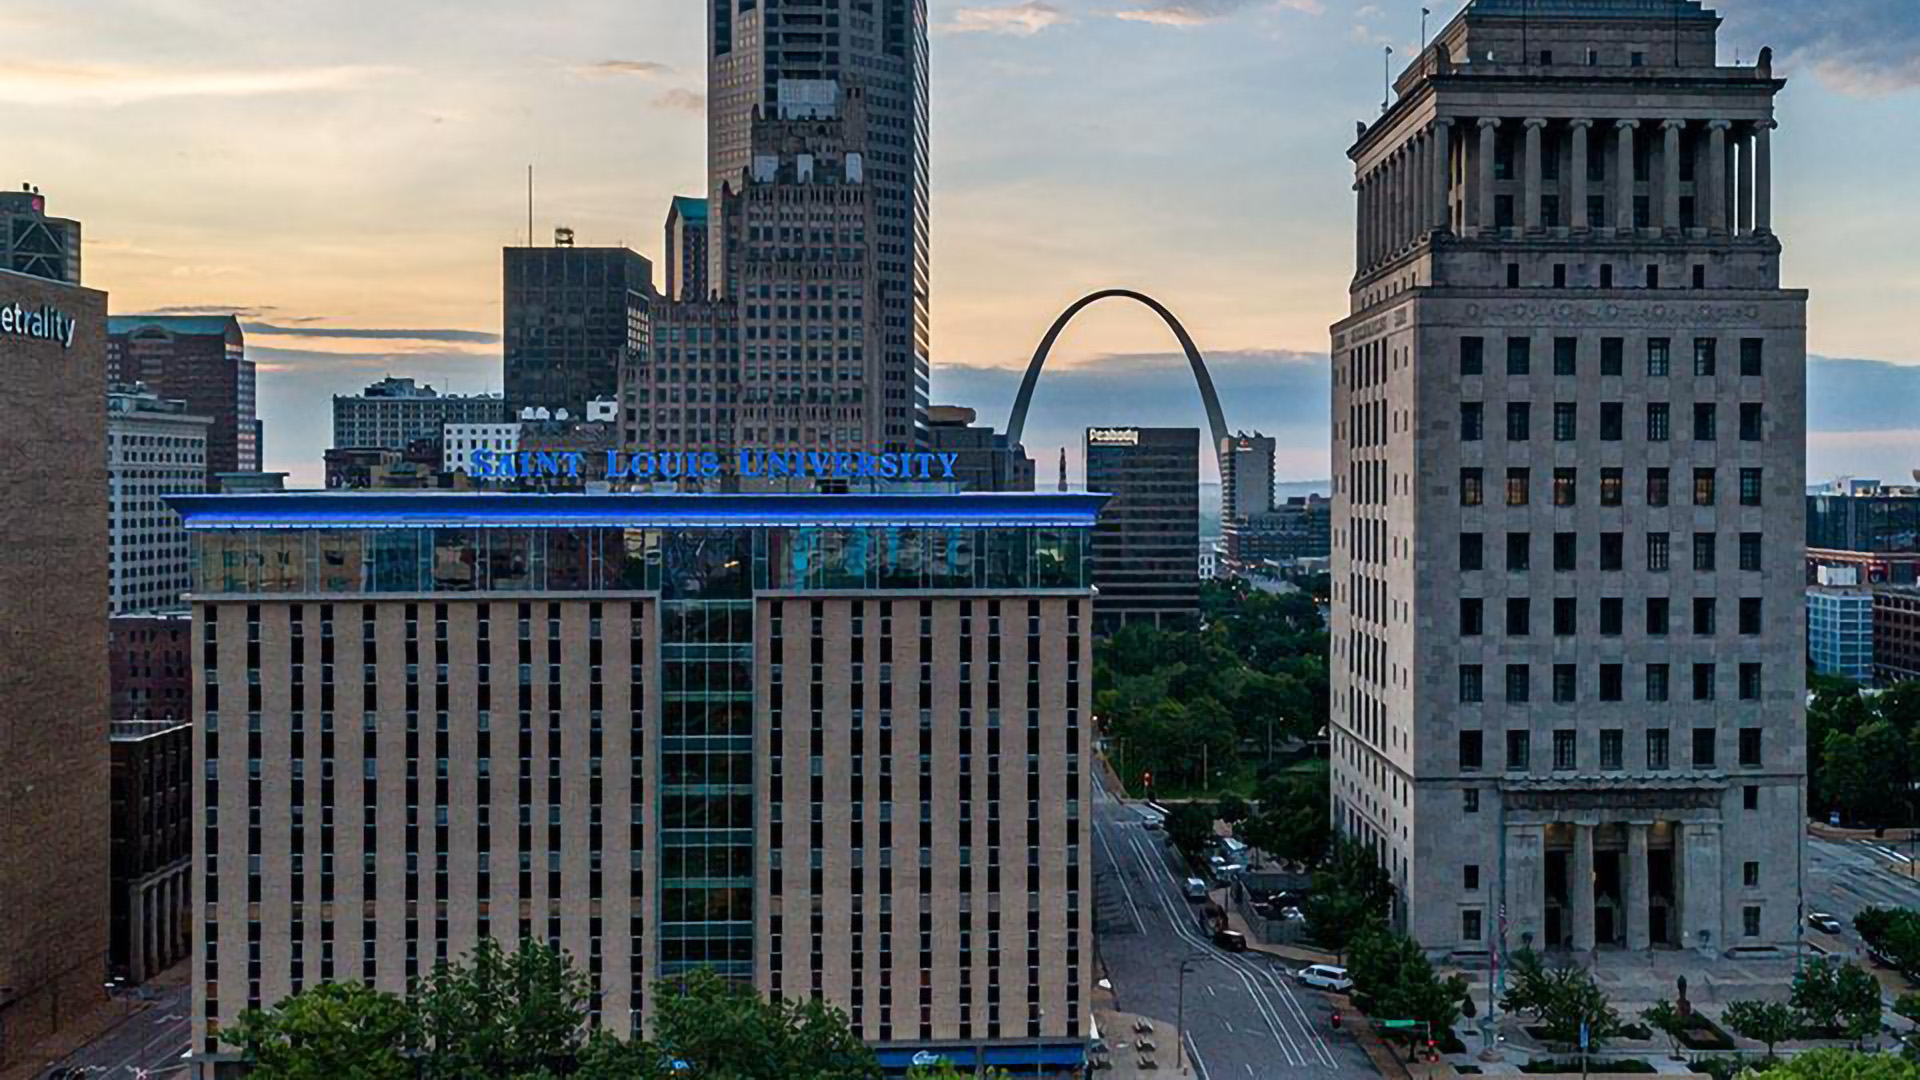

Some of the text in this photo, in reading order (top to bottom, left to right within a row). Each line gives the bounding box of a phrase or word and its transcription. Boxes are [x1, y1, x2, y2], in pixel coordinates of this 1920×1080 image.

[468, 448, 958, 478] SAINT LOUIS UNIVERSITY
